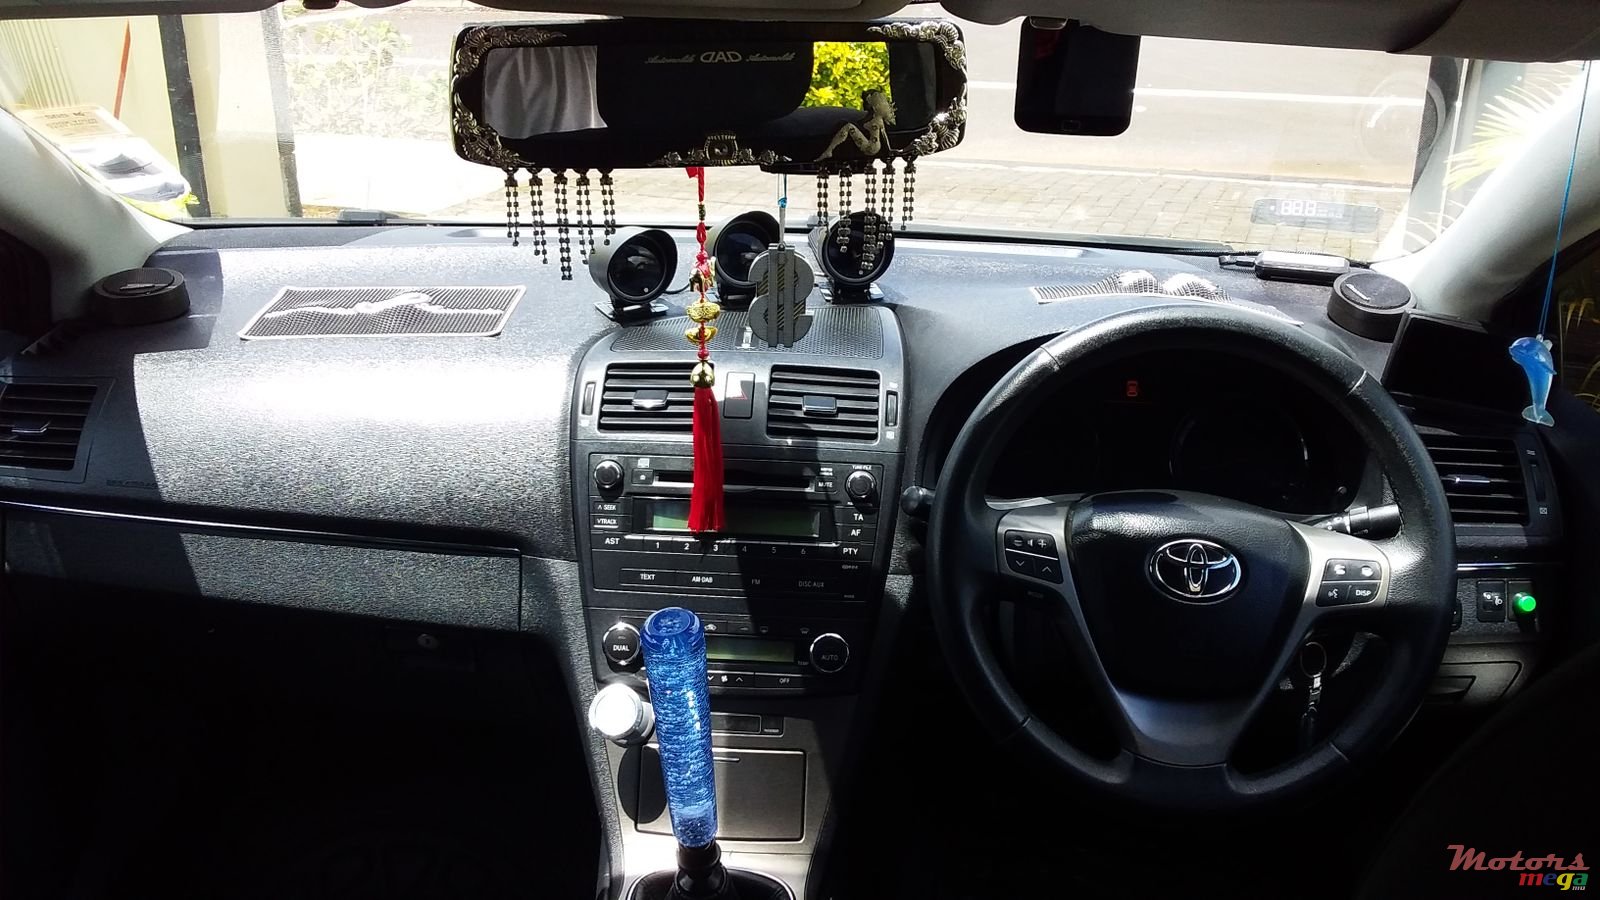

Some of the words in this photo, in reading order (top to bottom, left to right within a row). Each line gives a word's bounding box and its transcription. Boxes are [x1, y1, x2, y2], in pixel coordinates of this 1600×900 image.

[853, 513, 864, 521] TA
[850, 529, 862, 537] AF
[604, 537, 620, 545] AST
[842, 547, 859, 555] PTY
[640, 573, 656, 581] TEXT
[1355, 589, 1372, 597] DISP
[612, 644, 630, 652] DUAL
[821, 653, 839, 661] AUTO
[778, 676, 791, 685] OFF
